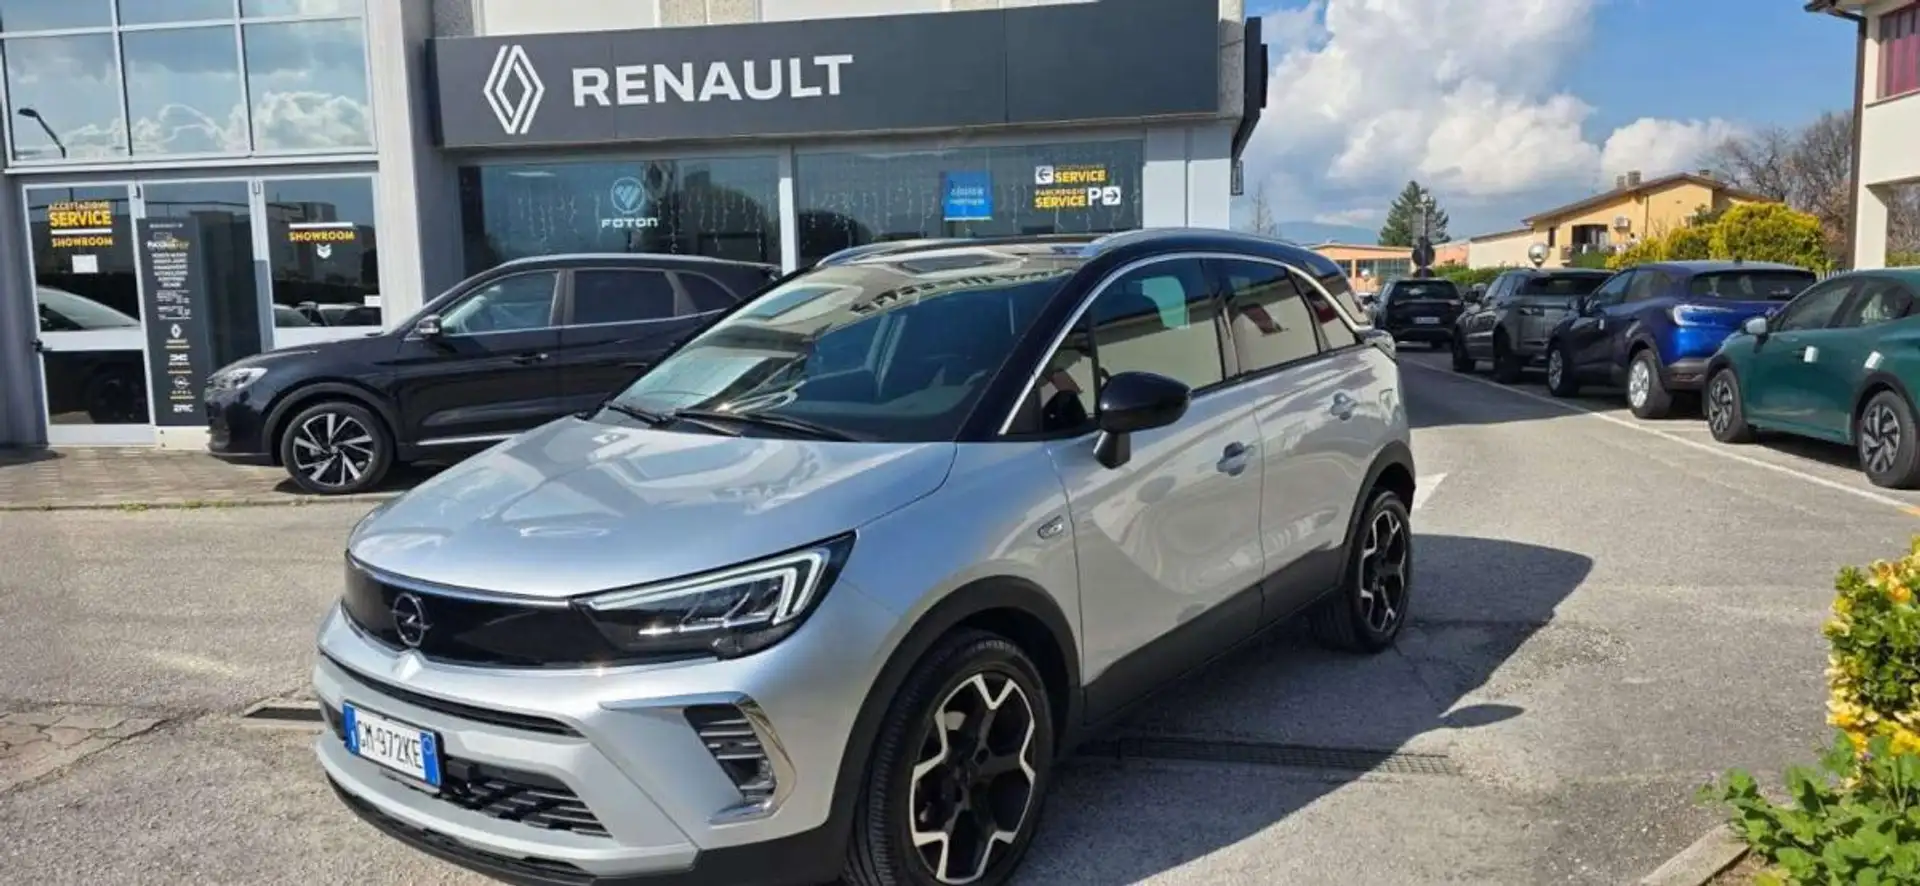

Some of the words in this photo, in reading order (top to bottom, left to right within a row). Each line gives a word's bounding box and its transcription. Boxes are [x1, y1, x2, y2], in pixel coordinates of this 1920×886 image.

[572, 54, 854, 107] RENAULT
[1055, 169, 1106, 183] SERVICE
[1035, 196, 1086, 208] SERVICE
[1087, 186, 1102, 206] P
[49, 210, 112, 227] SERVICE
[52, 236, 114, 248] SHOWROOM
[289, 230, 356, 242] SHOWROOM
